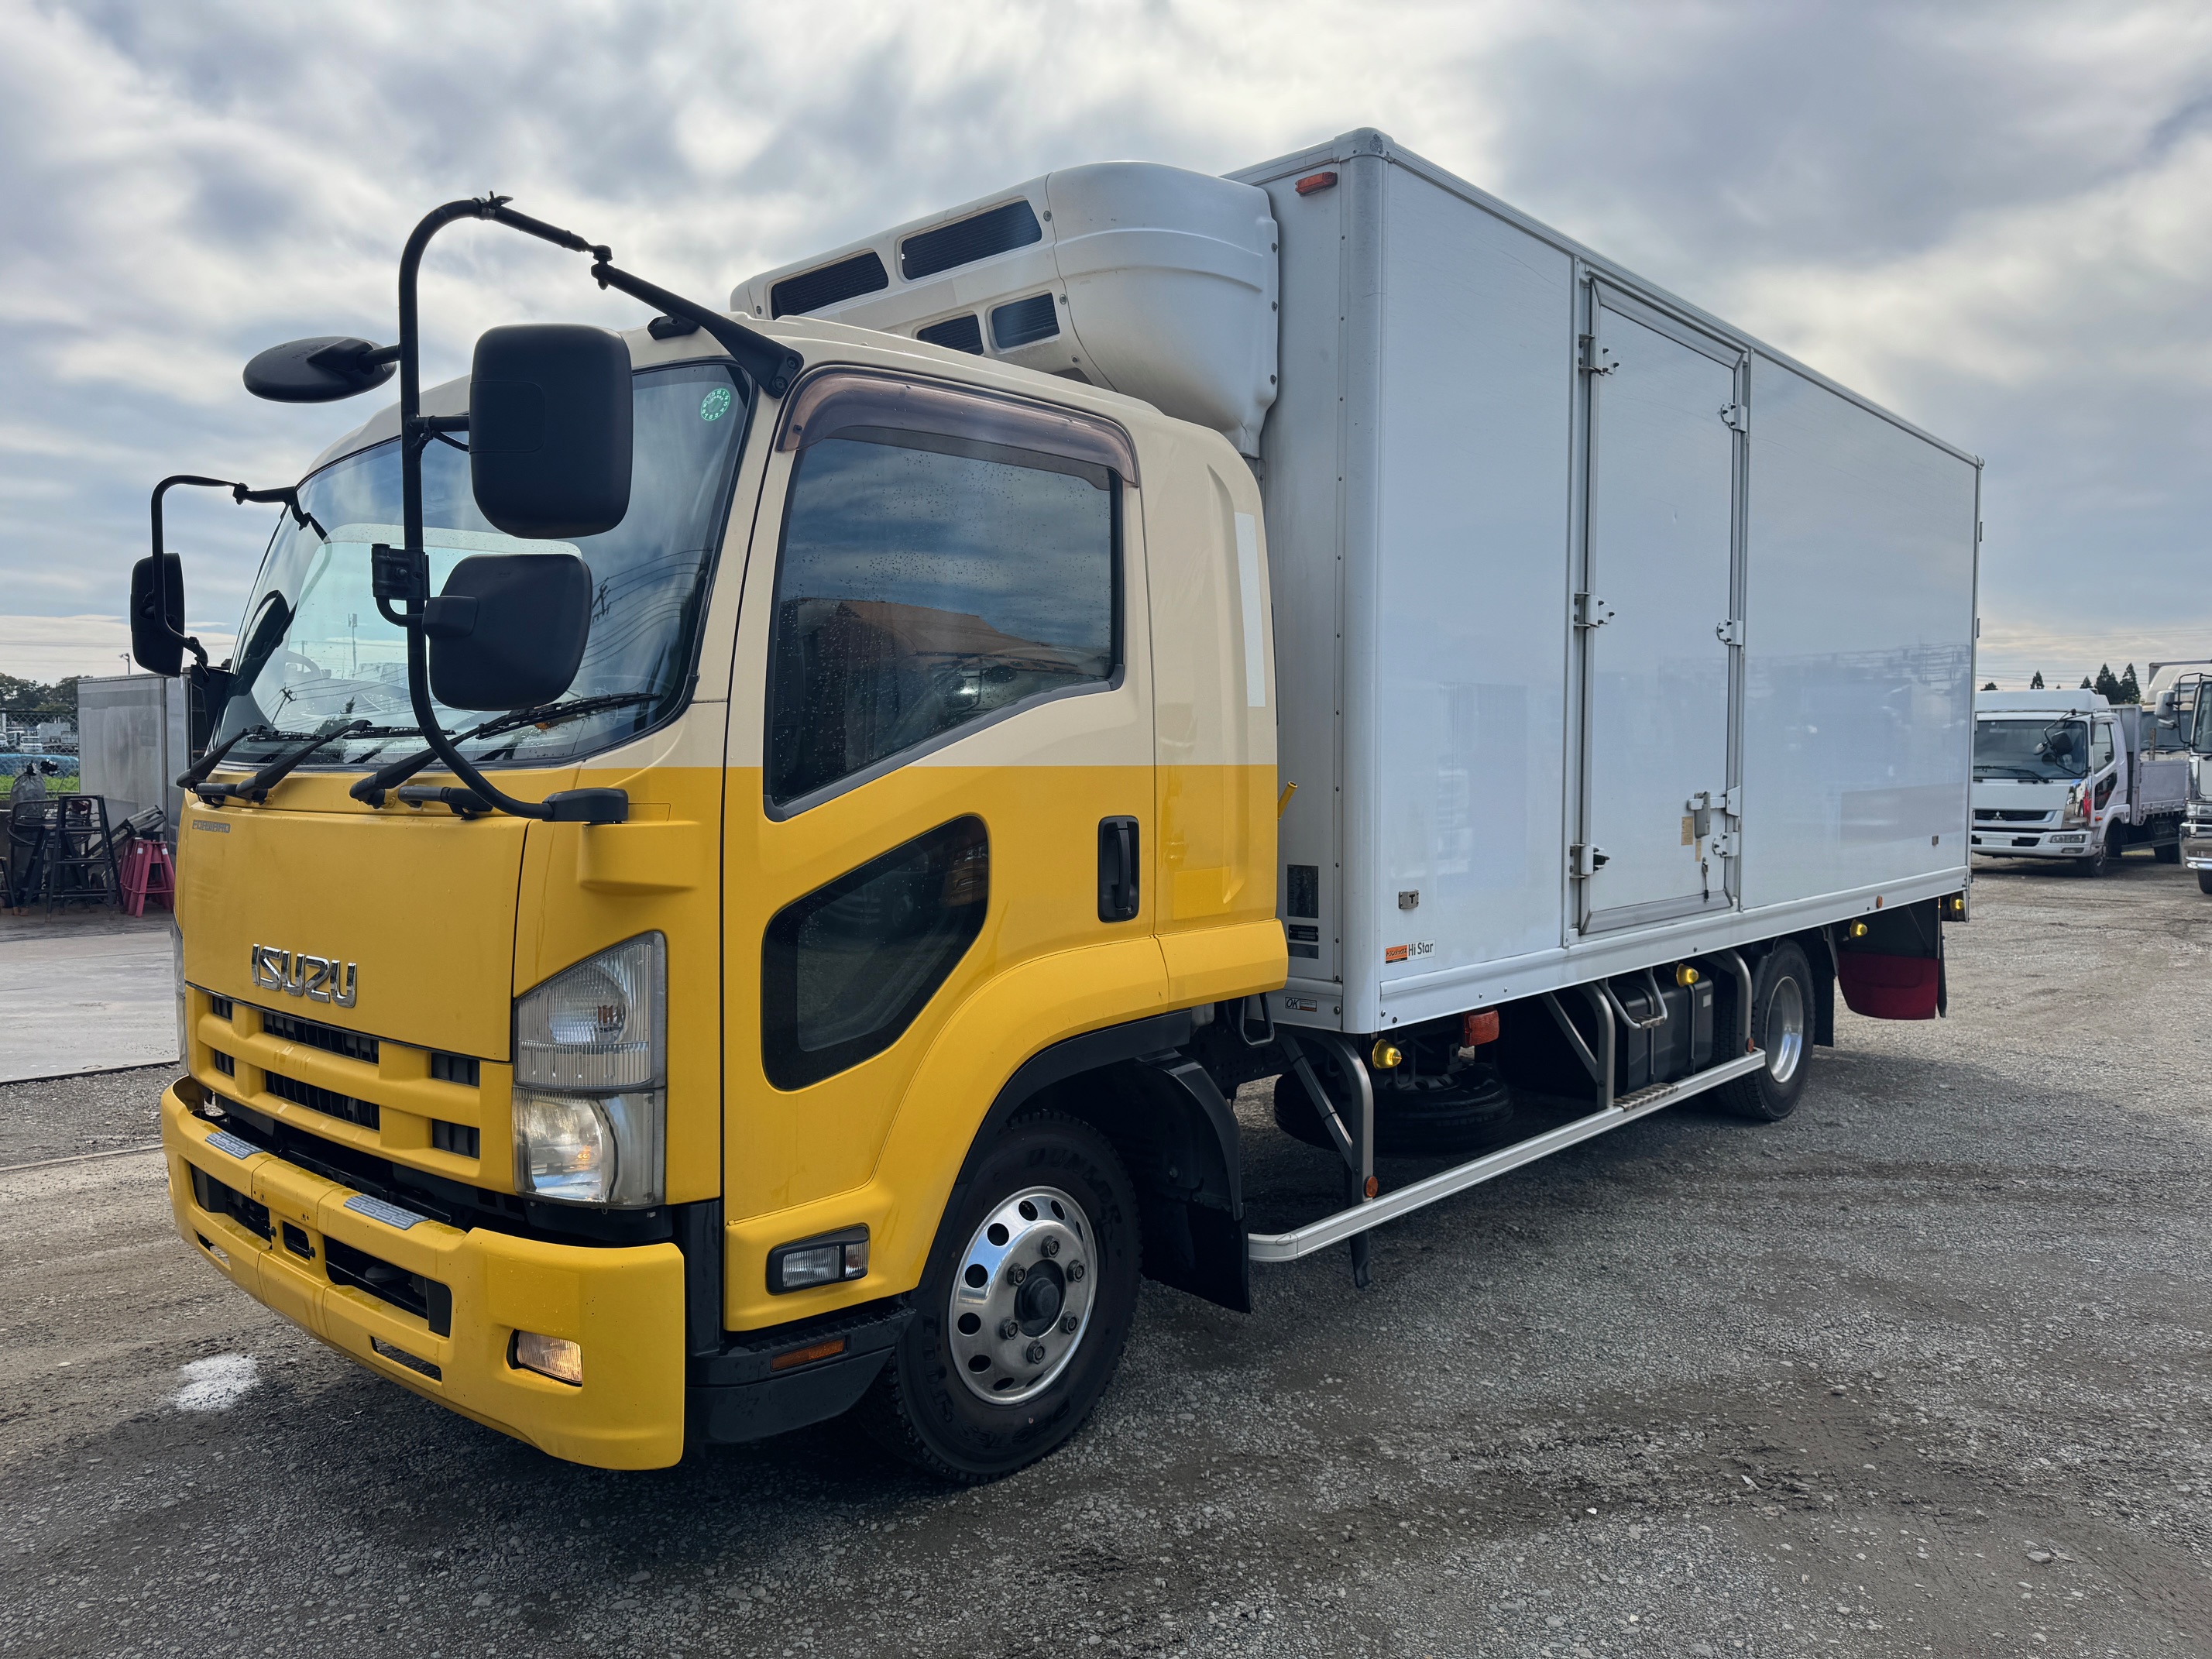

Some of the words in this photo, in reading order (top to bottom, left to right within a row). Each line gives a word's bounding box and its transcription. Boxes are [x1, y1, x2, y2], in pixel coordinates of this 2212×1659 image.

[192, 819, 231, 833] FORWARD
[1408, 943, 1416, 957] Hi
[1417, 942, 1434, 955] Star
[252, 943, 357, 1008] ISUZU
[1286, 998, 1300, 1008] OK
